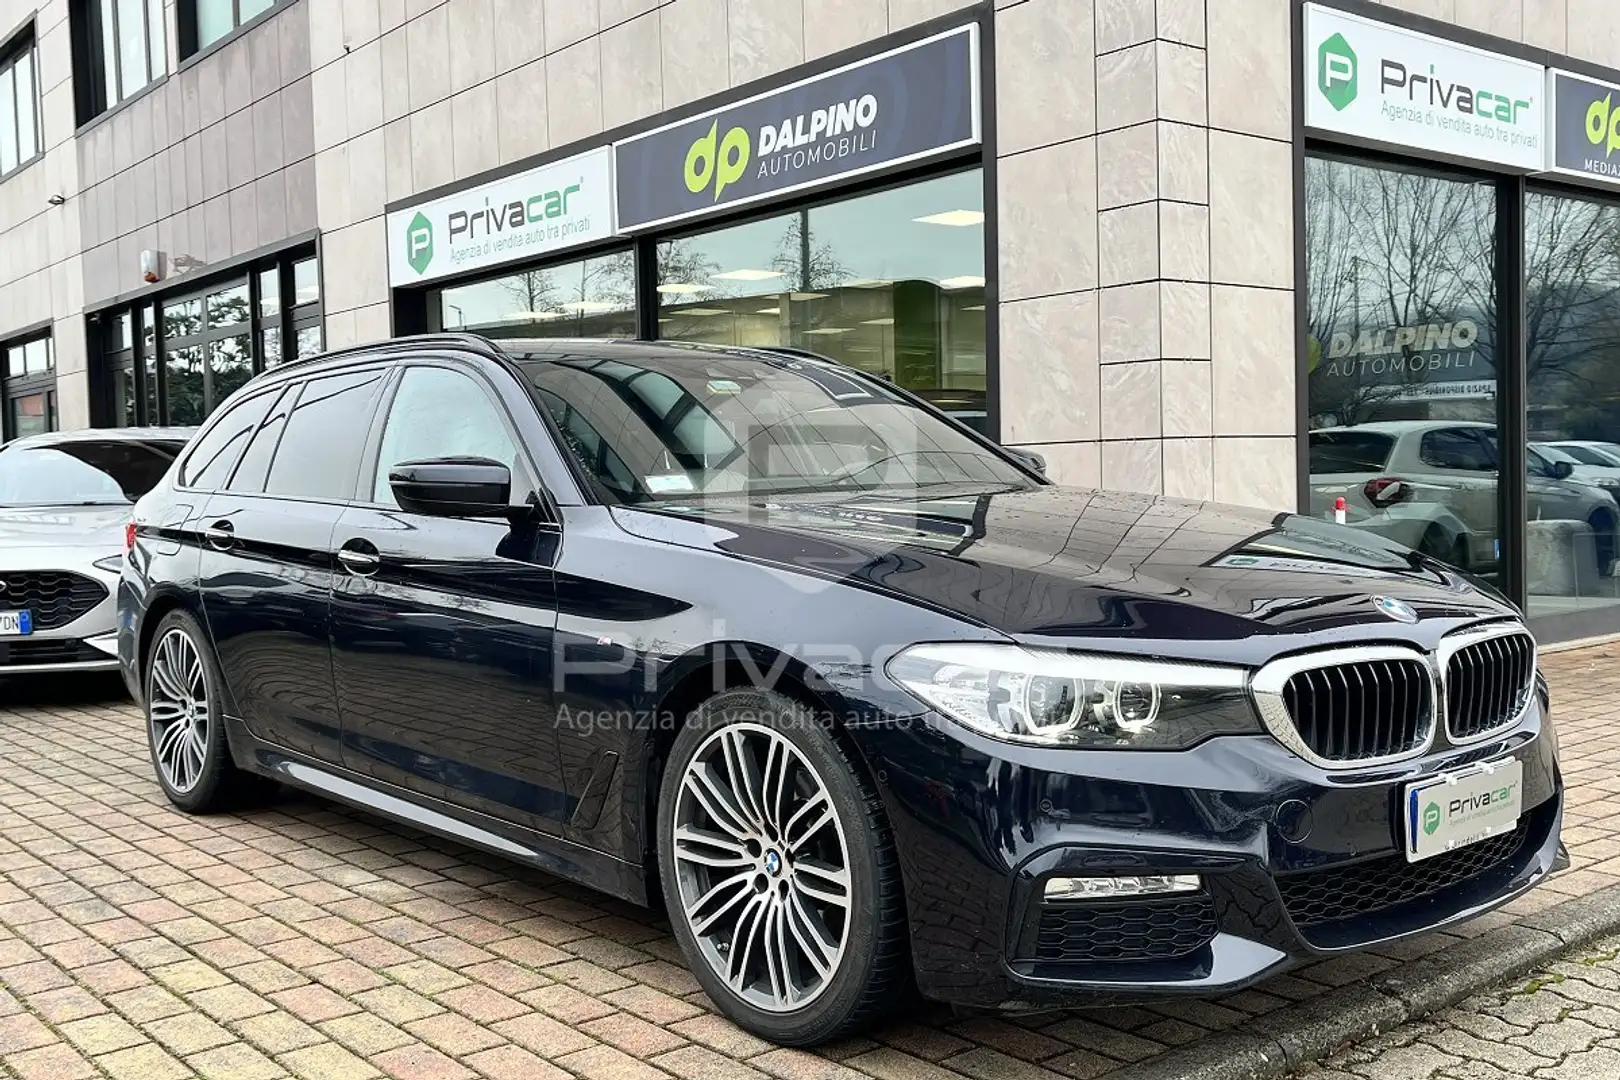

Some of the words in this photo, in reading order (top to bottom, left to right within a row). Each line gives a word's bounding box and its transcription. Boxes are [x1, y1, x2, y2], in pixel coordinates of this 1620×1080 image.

[1381, 58, 1529, 124] Privacar
[758, 94, 877, 157] DALPINO
[1381, 100, 1422, 123] Agenzia
[1425, 109, 1434, 125] di
[1436, 114, 1471, 135] vendita
[1474, 122, 1494, 139] auto
[1496, 127, 1508, 142] tra
[1511, 131, 1538, 148] privati
[757, 130, 876, 179] AUTOMOBILI
[1584, 158, 1620, 176] MEDIA
[449, 184, 580, 244] Privacar
[451, 243, 481, 264] Agenzia
[483, 239, 491, 254] di
[493, 234, 522, 251] vendita
[526, 229, 545, 244] auto
[547, 225, 559, 239] tra
[562, 218, 590, 240] privati
[1328, 320, 1478, 358] DALPINO
[1327, 351, 1475, 377] AUTOMOBILI
